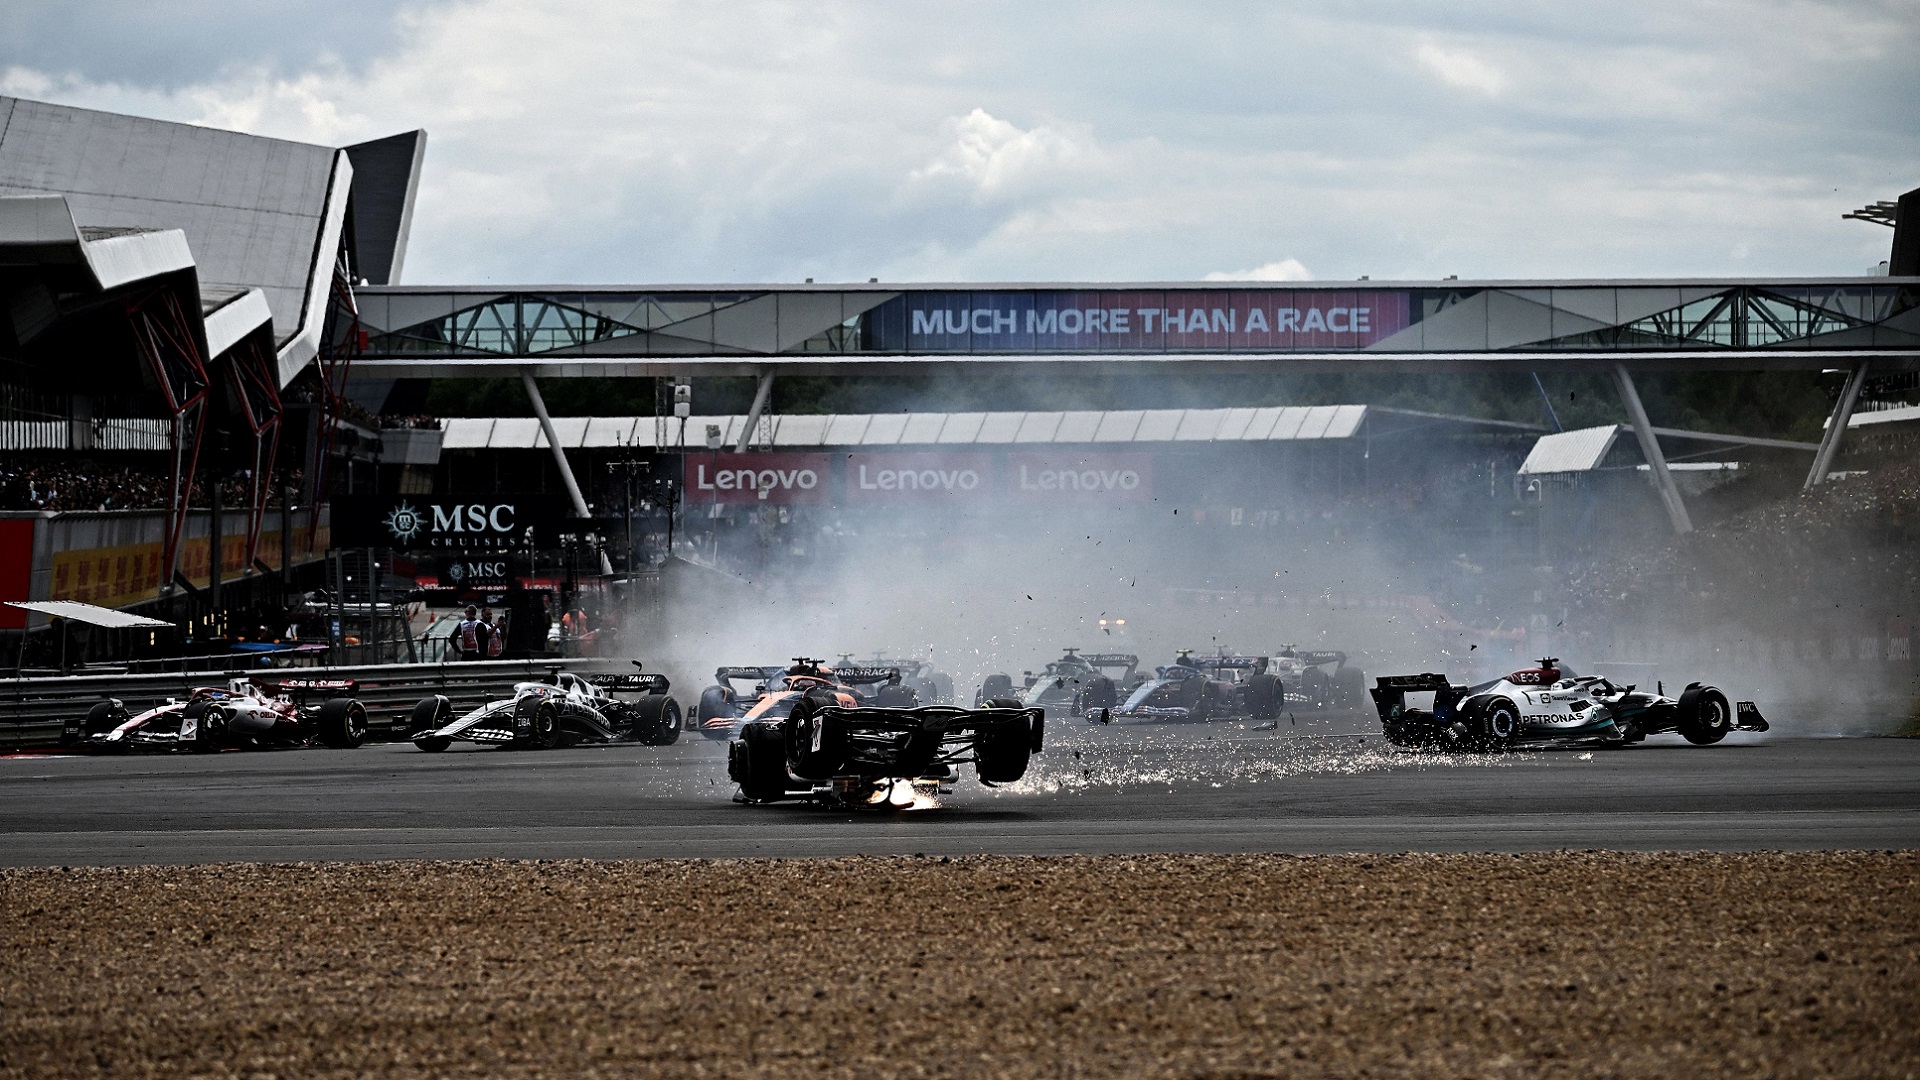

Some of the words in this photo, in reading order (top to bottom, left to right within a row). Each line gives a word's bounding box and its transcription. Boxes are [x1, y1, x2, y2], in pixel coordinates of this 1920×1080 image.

[912, 308, 1017, 335] MUCH
[1026, 308, 1131, 334] MORE
[1137, 308, 1236, 333] THAN
[1244, 308, 1269, 333] A
[1277, 308, 1372, 333] RACE
[698, 465, 818, 490] Lenovo
[859, 465, 980, 491] Lenovo
[1020, 465, 1140, 491] Lenovo
[431, 504, 516, 533] MSC
[431, 537, 516, 546] CRUISES
[467, 562, 507, 579] MSC
[628, 675, 656, 683] TAURI
[1511, 672, 1541, 683] INEOS
[1738, 703, 1755, 713] IWC
[1522, 712, 1585, 726] PETRONAS
